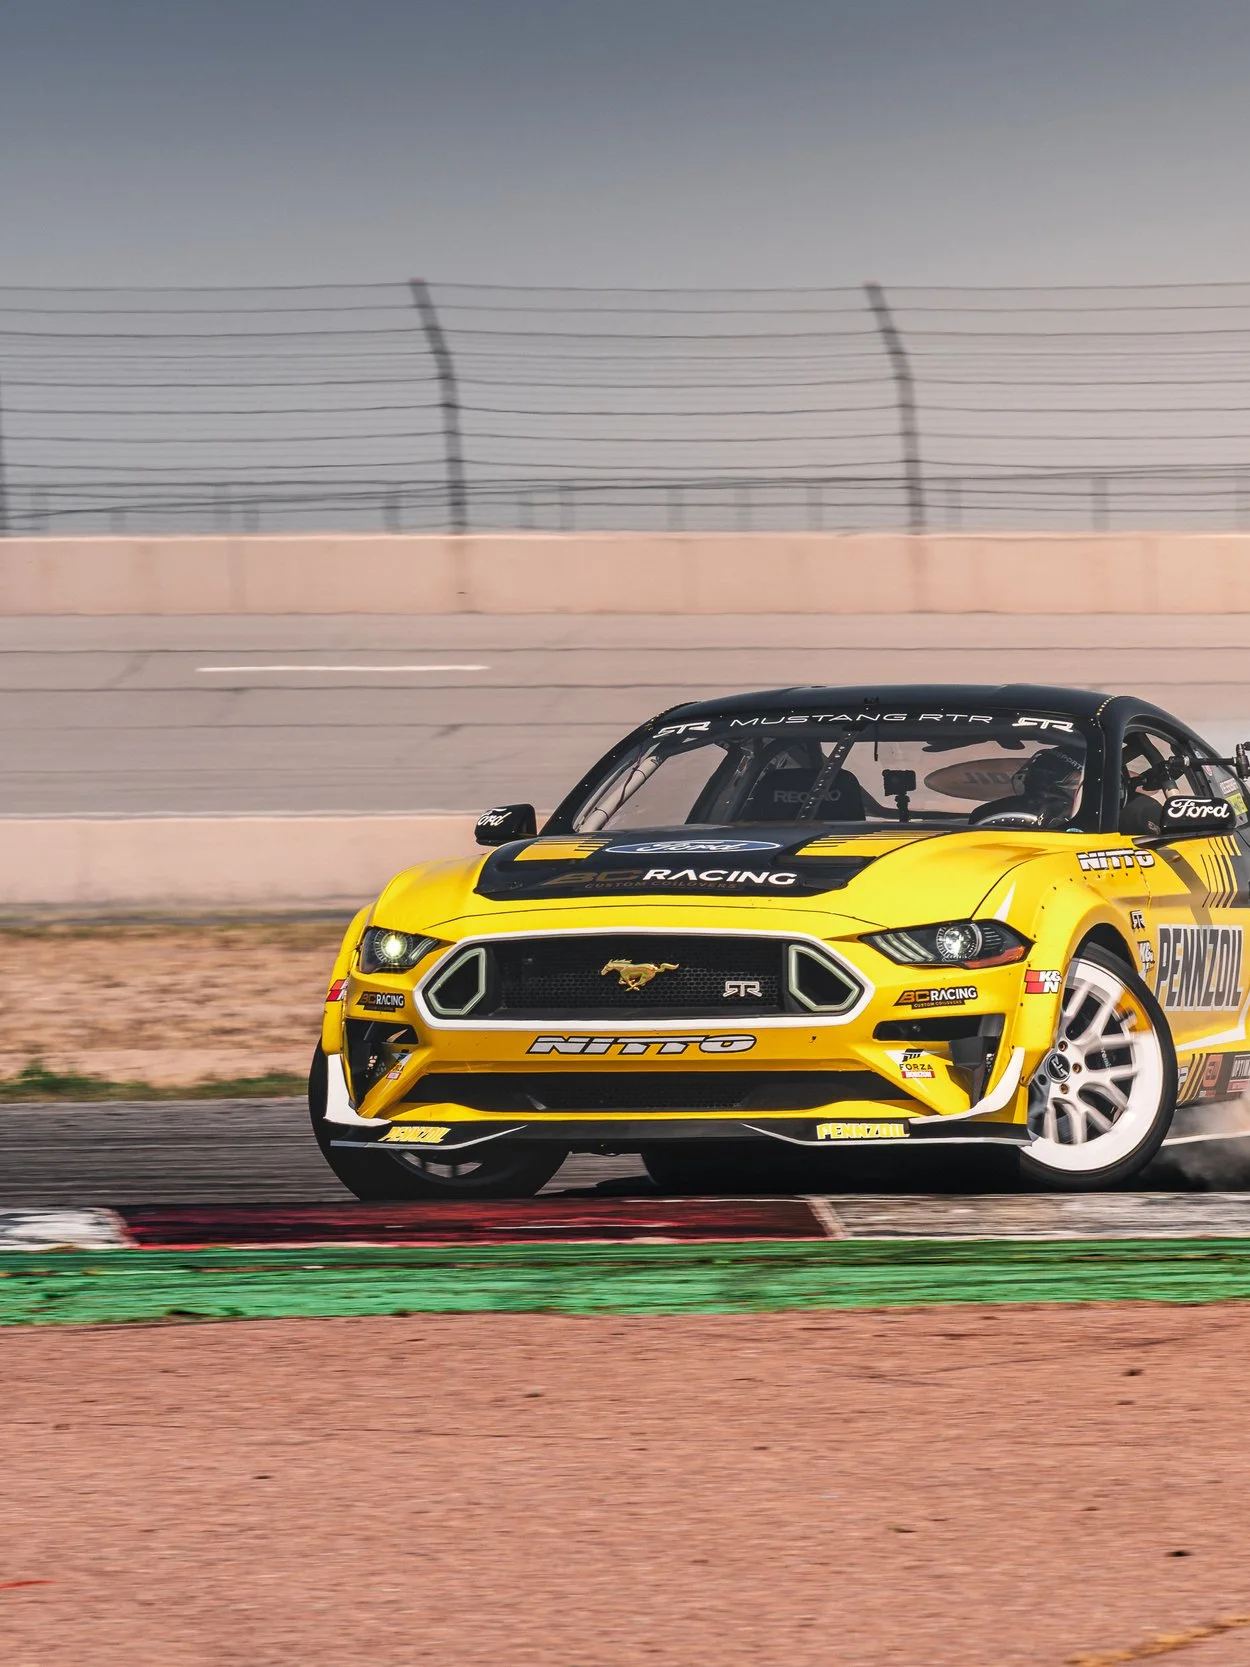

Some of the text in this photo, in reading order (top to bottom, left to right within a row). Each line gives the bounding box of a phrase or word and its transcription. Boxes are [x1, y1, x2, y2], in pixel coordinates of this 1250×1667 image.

[730, 713, 993, 727] MUSTANG RTR
[1167, 799, 1230, 820] Ford
[636, 840, 748, 852] Ford
[1077, 848, 1155, 872] NITTO
[642, 869, 798, 886] RACING
[1154, 925, 1244, 1011] PENNZOIL
[375, 993, 404, 1006] RACING
[929, 987, 977, 1001] RACING
[525, 1034, 757, 1056] NITTO
[899, 1063, 935, 1071] FORZA
[377, 1125, 451, 1144] PENNZOIL
[817, 1122, 911, 1140] PENNZOIL
